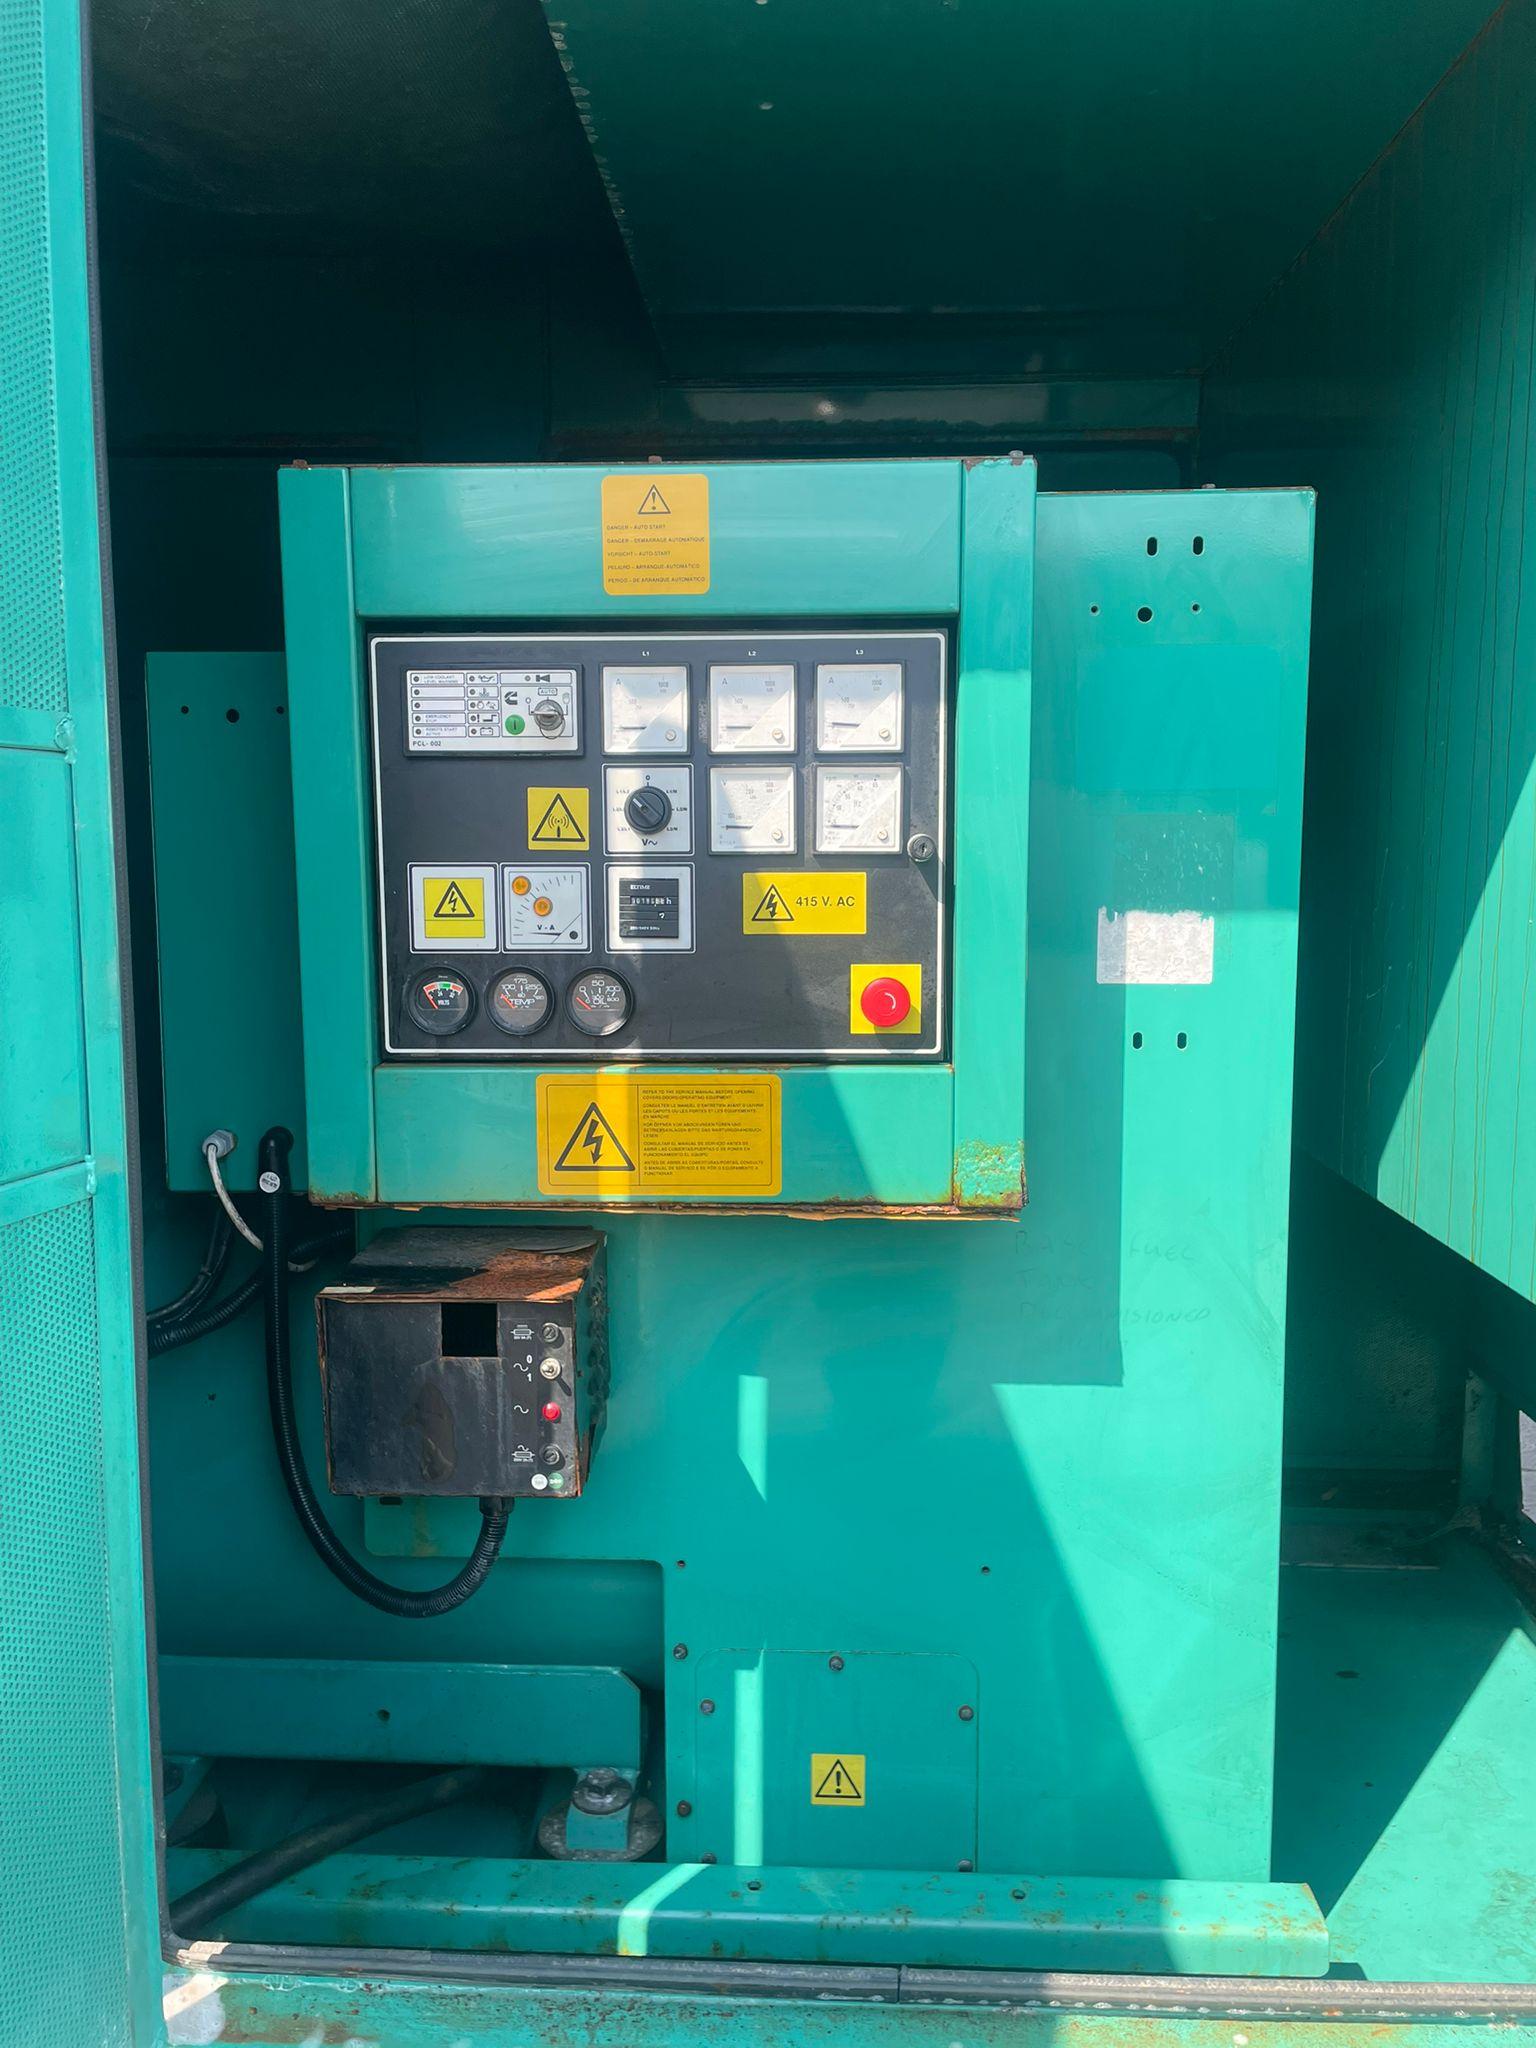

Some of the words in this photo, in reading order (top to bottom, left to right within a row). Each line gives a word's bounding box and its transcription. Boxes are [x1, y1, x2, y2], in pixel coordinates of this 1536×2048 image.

[796, 896, 818, 907] 415
[822, 896, 832, 907] V.
[836, 896, 856, 907] AC
[509, 998, 536, 1006] TEMP
[526, 1354, 532, 1364] 0
[526, 1372, 532, 1382] 1
